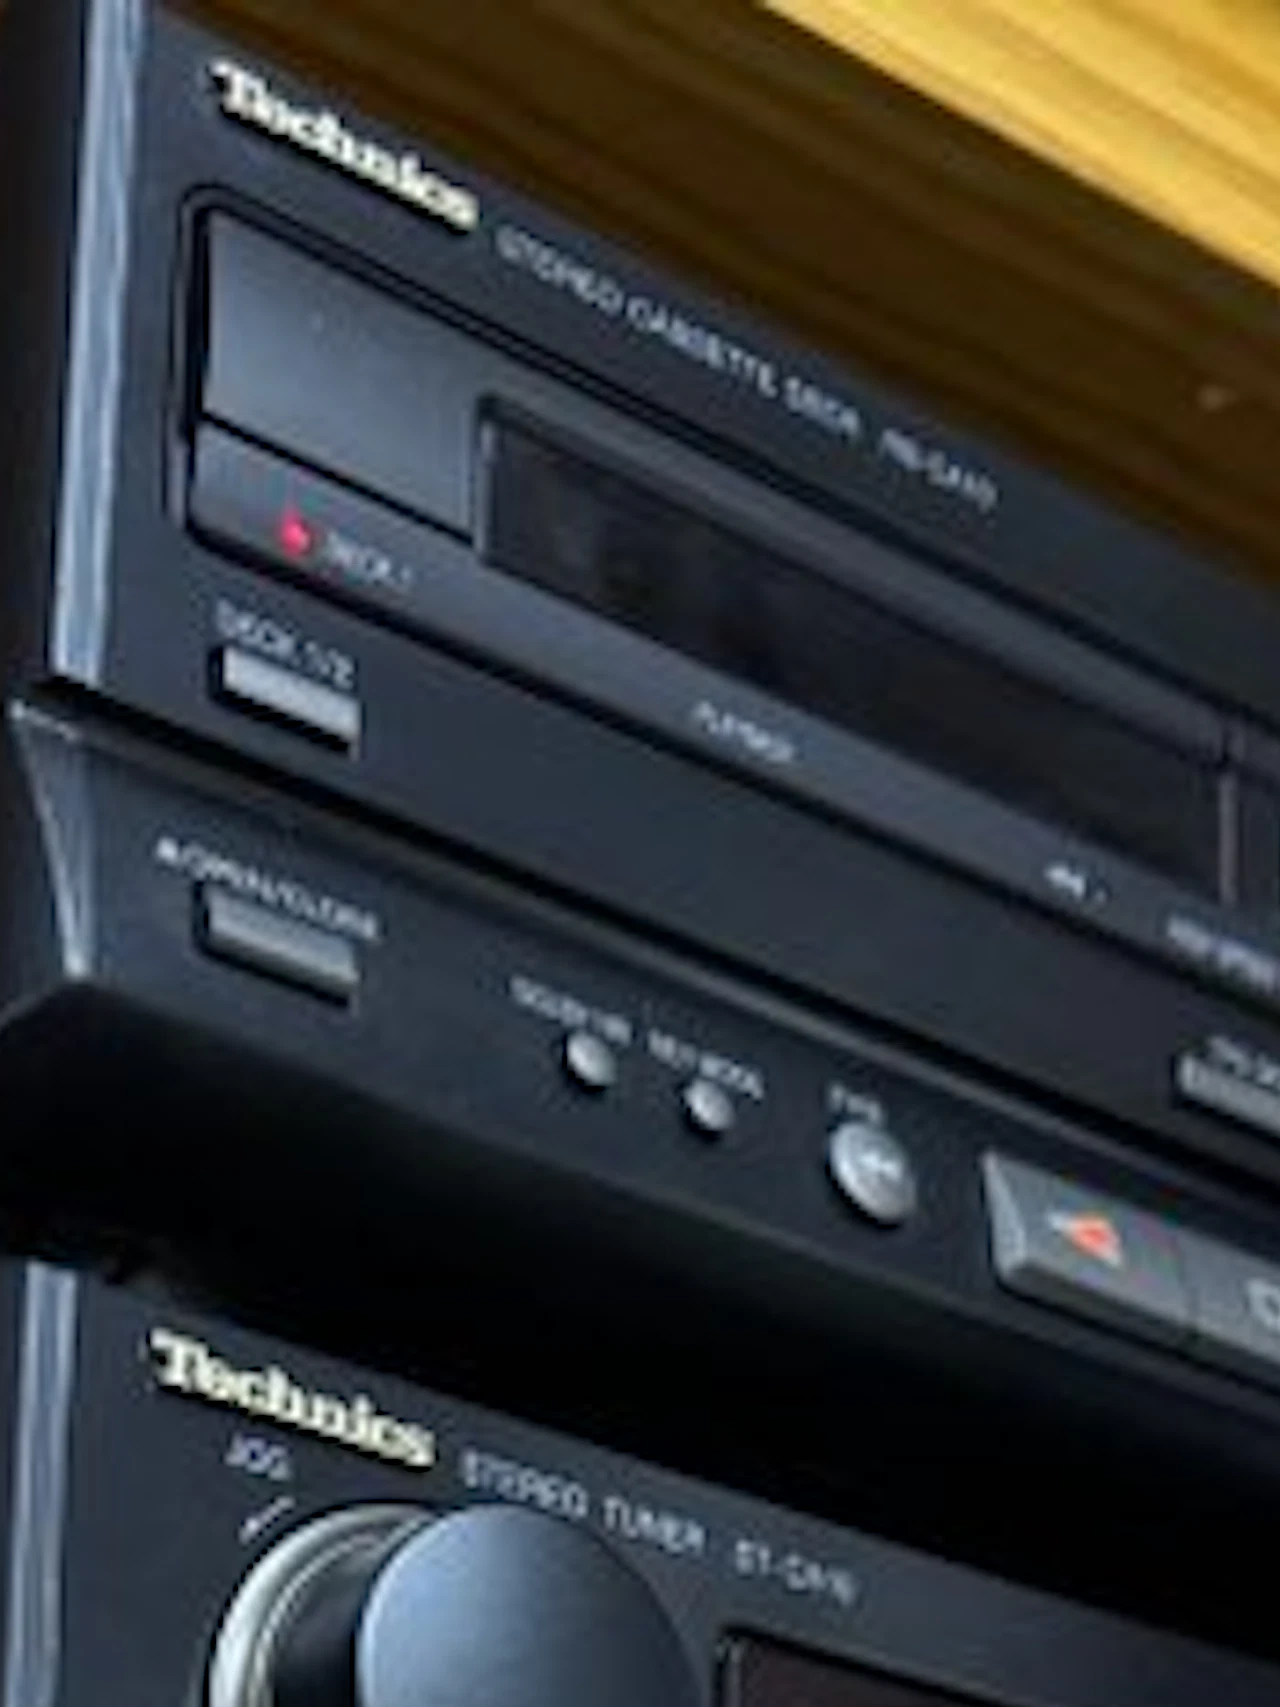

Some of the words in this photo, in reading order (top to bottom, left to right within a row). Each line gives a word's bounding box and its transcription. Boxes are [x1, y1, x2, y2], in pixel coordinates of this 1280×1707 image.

[210, 58, 482, 236] Technics
[146, 1328, 438, 1470] Technics
[462, 1450, 590, 1518] STEREO
[602, 1494, 710, 1558] TUNER
